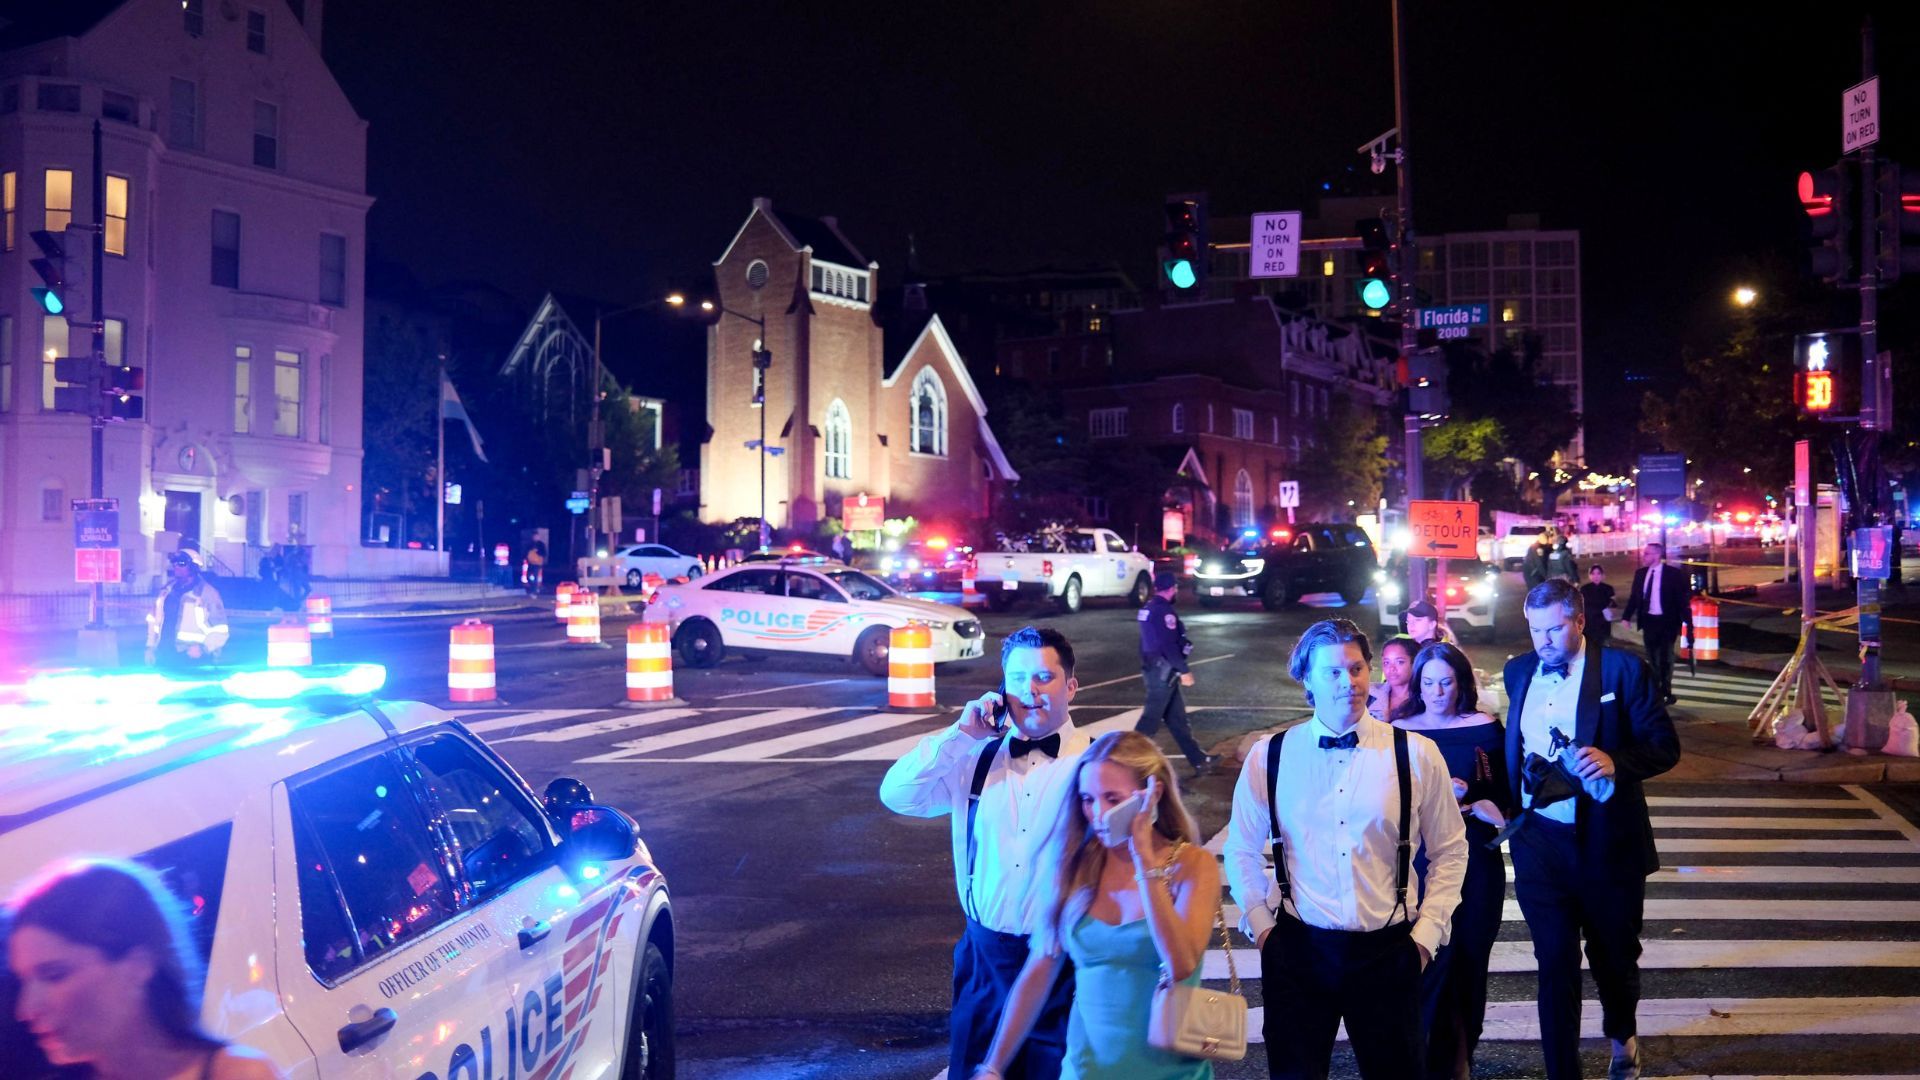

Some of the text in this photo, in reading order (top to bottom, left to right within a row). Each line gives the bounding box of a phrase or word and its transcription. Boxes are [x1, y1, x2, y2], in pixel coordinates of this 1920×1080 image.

[1854, 91, 1867, 105] NO
[1850, 107, 1870, 124] TURN
[1847, 122, 1875, 144] ON RED
[1265, 218, 1288, 231] NO
[1261, 234, 1290, 245] TURN
[1267, 248, 1283, 258] ON
[1263, 261, 1286, 272] RED
[1424, 308, 1469, 326] Florida
[1438, 327, 1468, 339] 2000
[1807, 375, 1832, 408] 30
[1413, 524, 1471, 538] DETOUR
[721, 608, 807, 629] POLICE
[378, 922, 492, 999] OFFICER OF THE MONTH
[416, 971, 563, 1080] LICE
